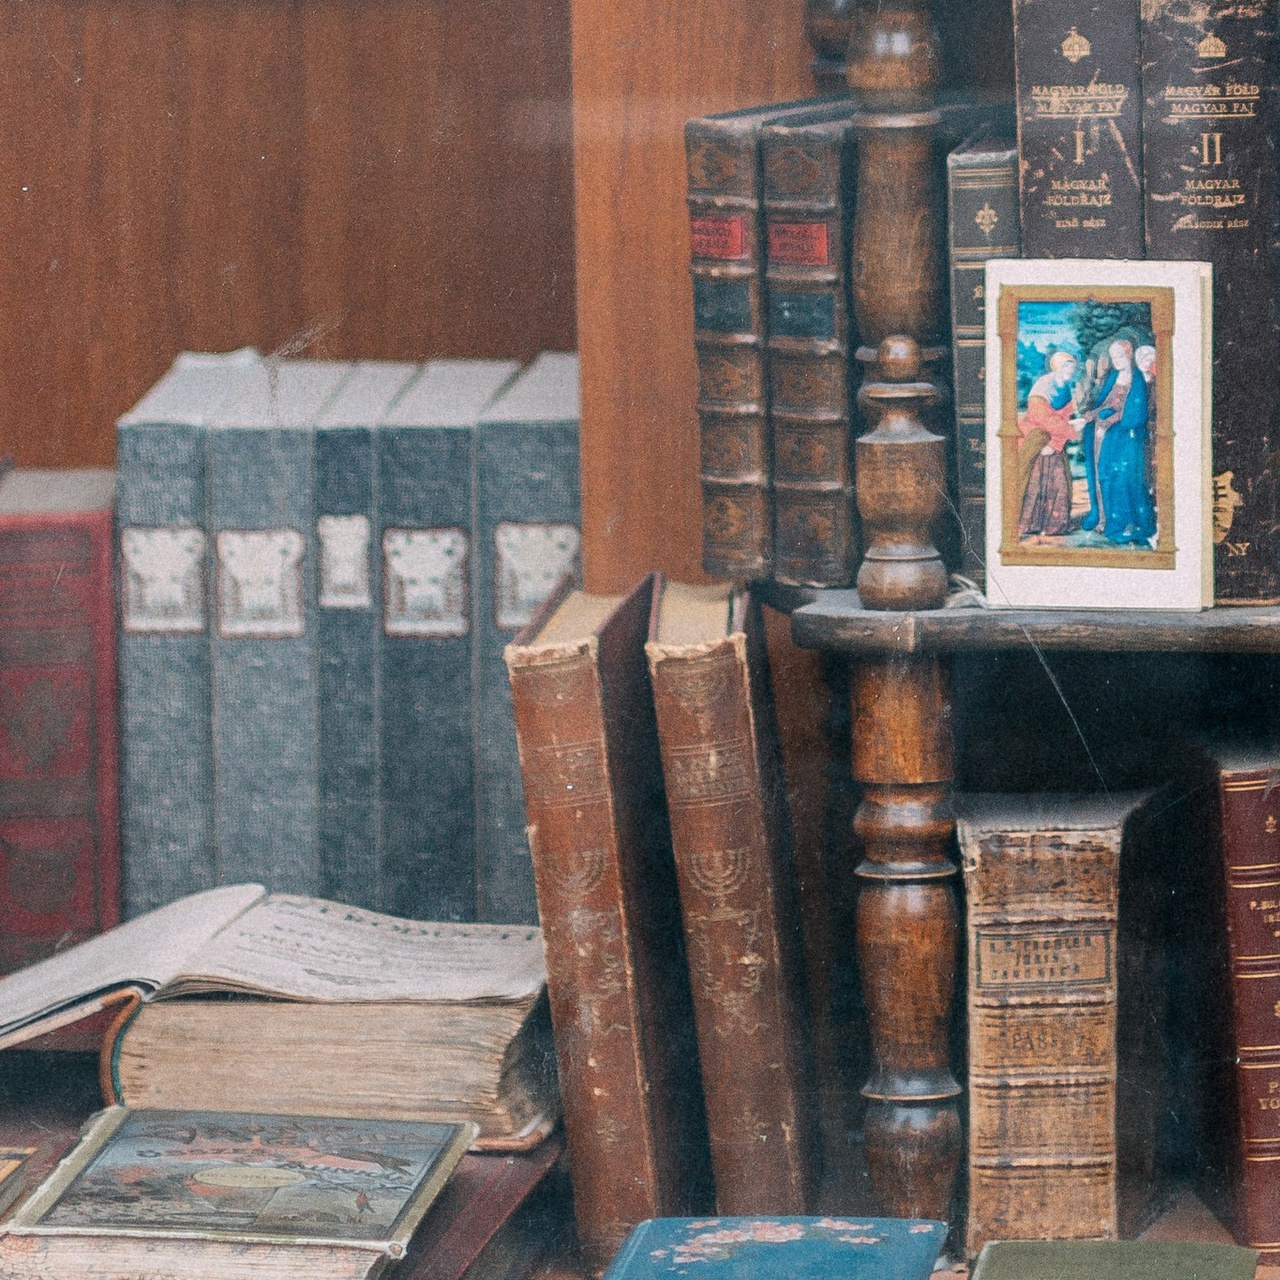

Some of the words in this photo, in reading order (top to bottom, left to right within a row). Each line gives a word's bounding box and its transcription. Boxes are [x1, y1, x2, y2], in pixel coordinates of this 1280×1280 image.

[1164, 84, 1221, 96] MAGYAR
[1225, 82, 1260, 96] FÖLD
[1171, 102, 1229, 115] MAGYAR
[1232, 101, 1256, 115] FAJ
[1200, 131, 1223, 166] II
[1051, 179, 1107, 191] MAGYAR
[1184, 178, 1241, 190] MAGYAR
[1227, 542, 1251, 557] NY
